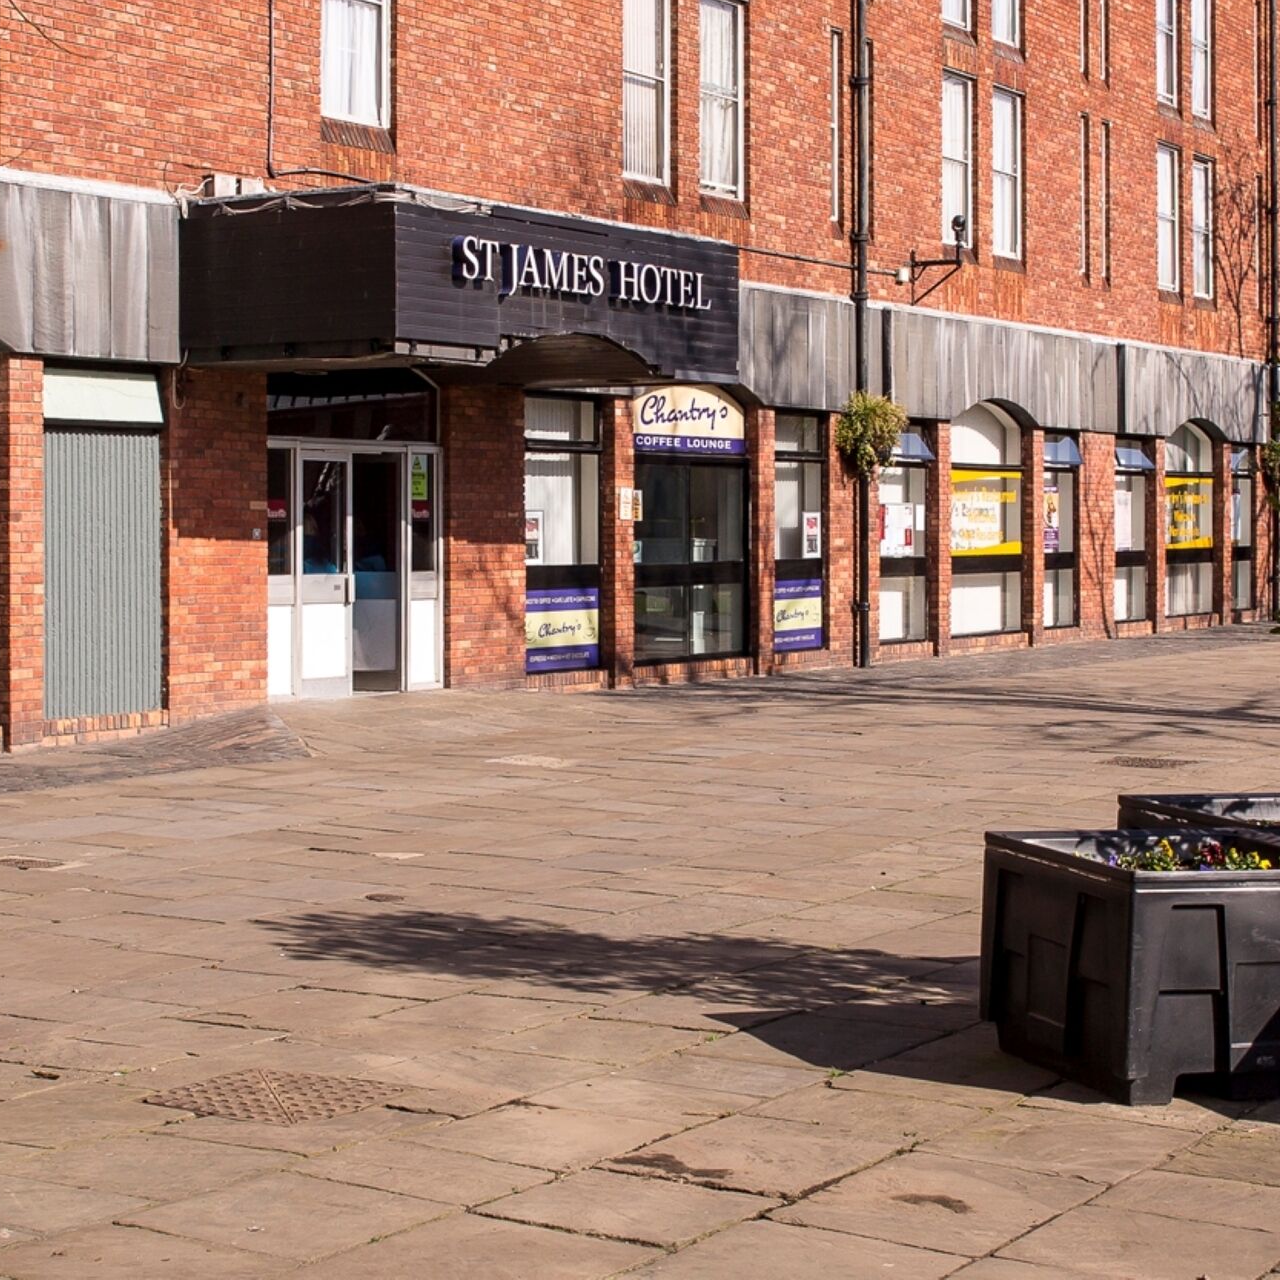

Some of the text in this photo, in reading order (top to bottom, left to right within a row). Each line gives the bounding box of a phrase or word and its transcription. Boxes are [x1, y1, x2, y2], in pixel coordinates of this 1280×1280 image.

[462, 236, 713, 310] ST JAMES HOTEL
[640, 394, 729, 431] Chantry's
[635, 435, 732, 450] COFFEE LOUNGE
